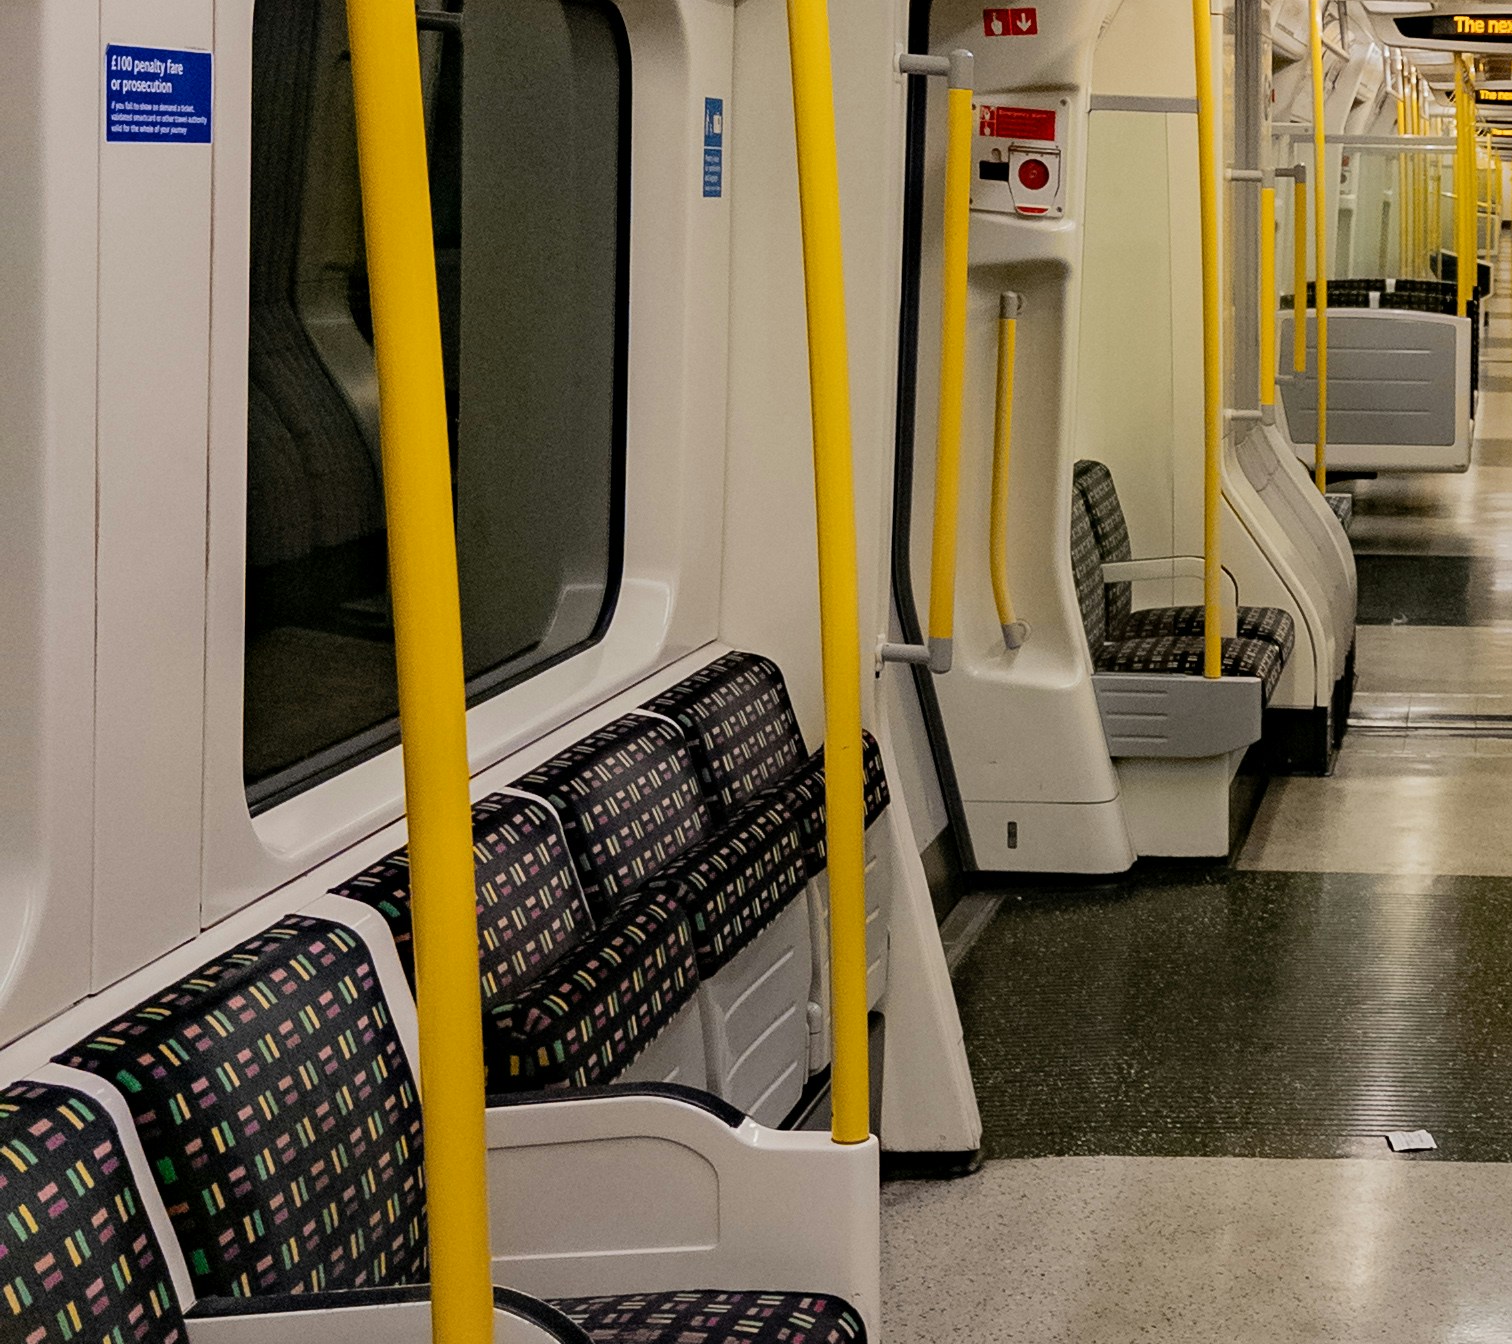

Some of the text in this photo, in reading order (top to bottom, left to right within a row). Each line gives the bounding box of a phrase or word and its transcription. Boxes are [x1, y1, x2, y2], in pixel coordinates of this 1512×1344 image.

[1453, 16, 1485, 33] The
[111, 55, 184, 77] £100 penalty fare
[111, 79, 172, 94] or prosecution
